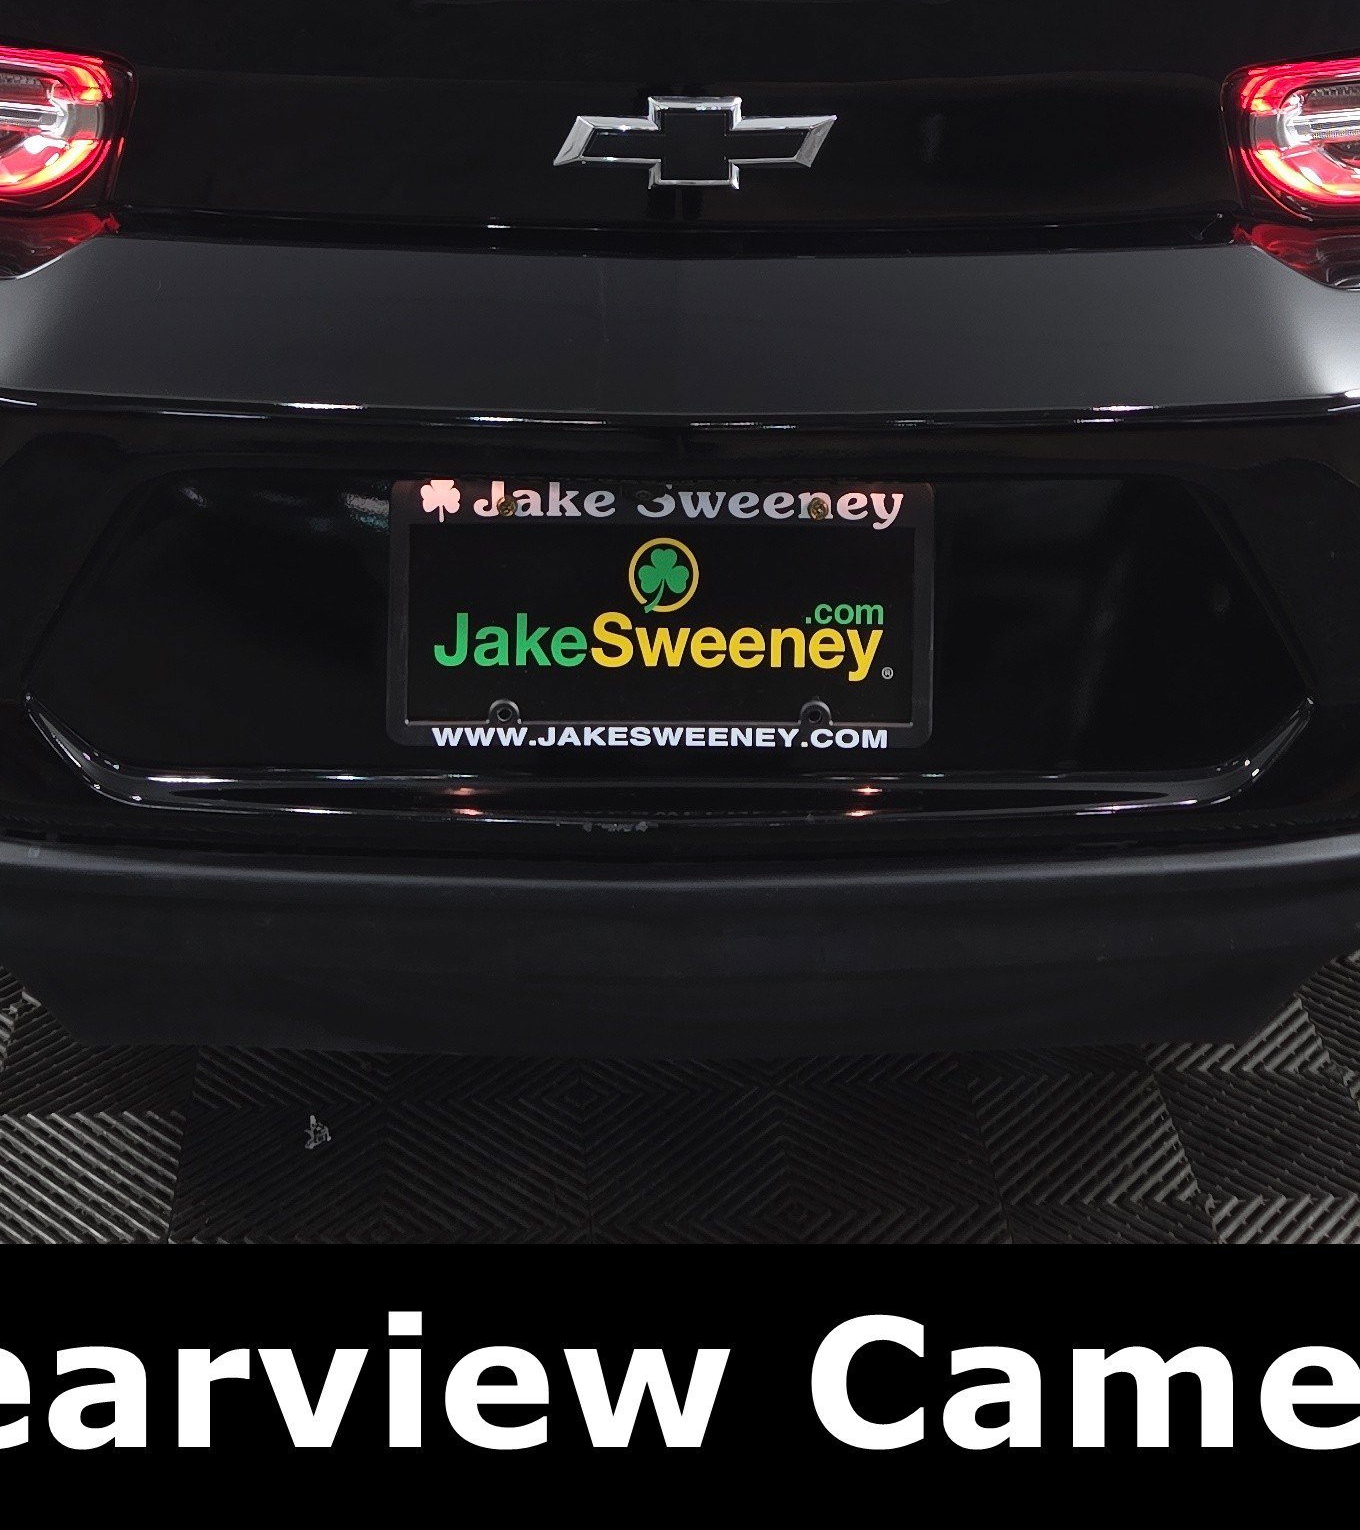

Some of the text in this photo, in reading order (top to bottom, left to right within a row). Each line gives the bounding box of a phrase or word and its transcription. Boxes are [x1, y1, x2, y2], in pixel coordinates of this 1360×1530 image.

[473, 481, 616, 518] Jake
[434, 611, 883, 682] JakeSweeney
[432, 727, 888, 749] WWW.JAKESWEENEY.COM
